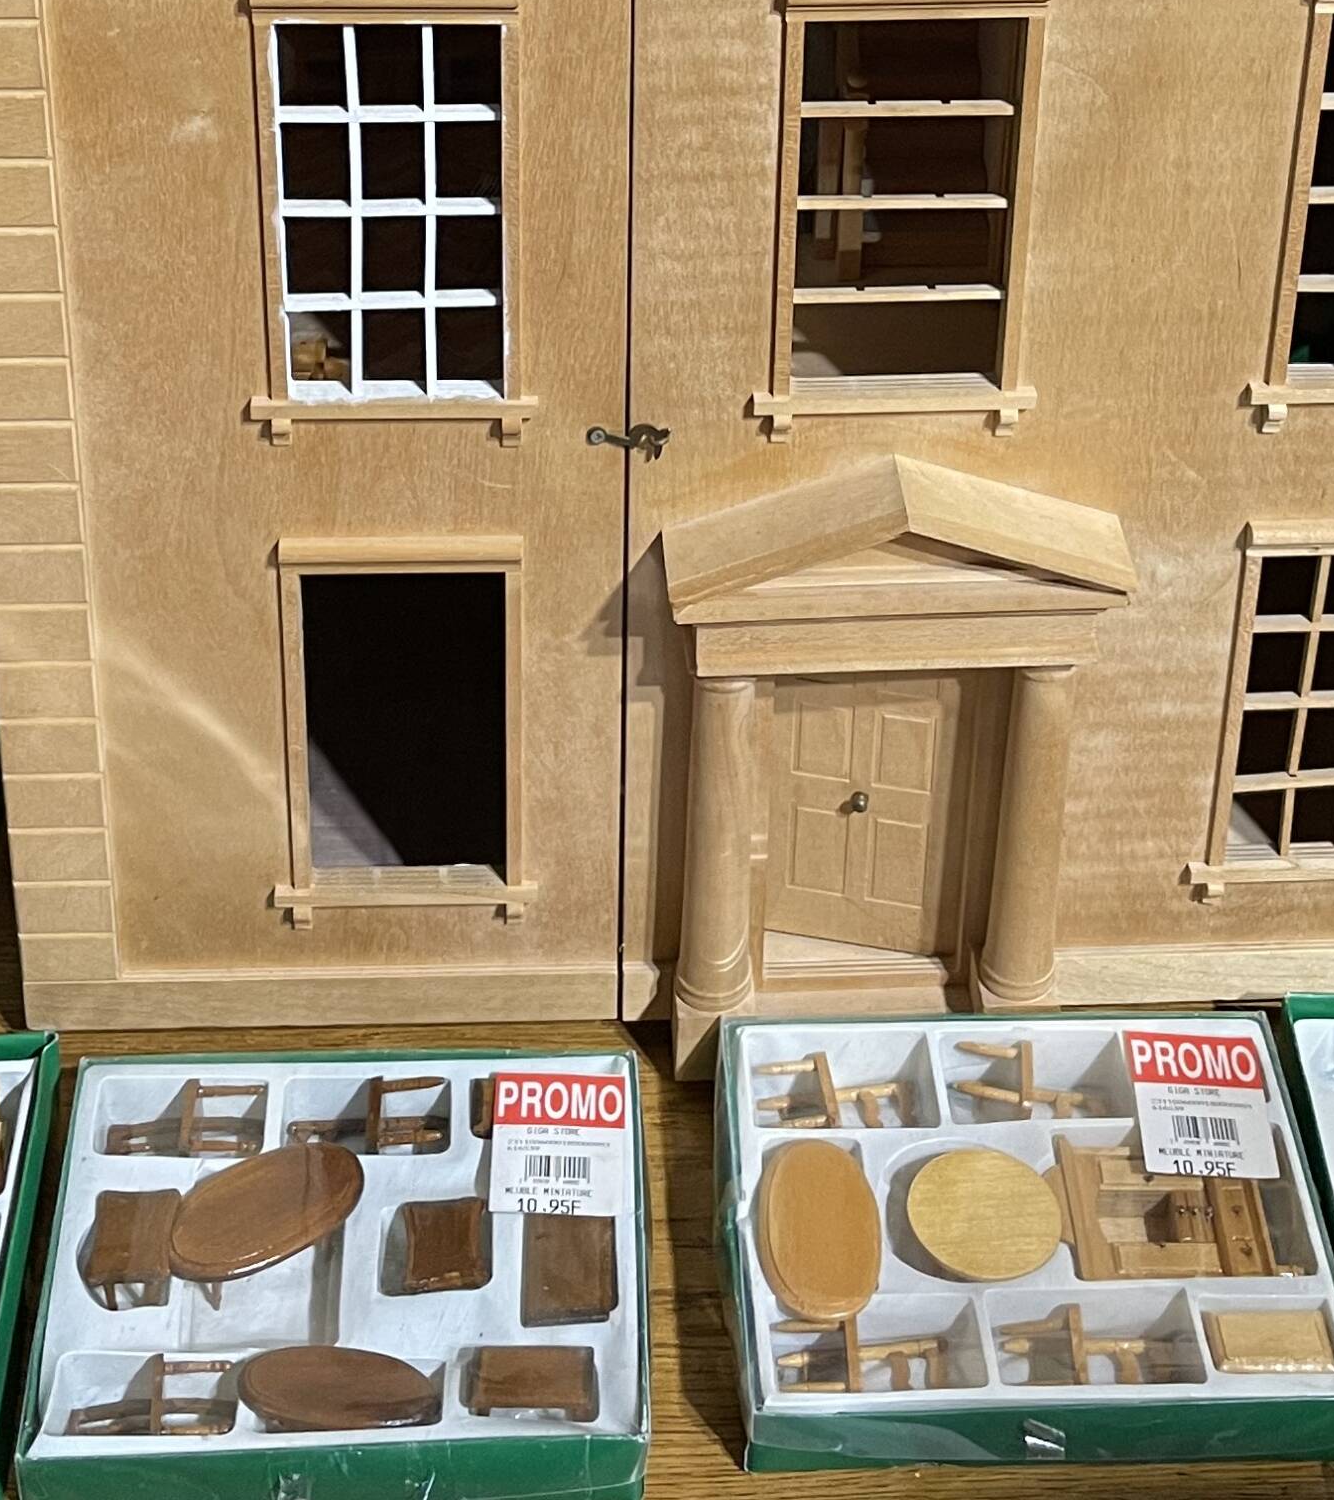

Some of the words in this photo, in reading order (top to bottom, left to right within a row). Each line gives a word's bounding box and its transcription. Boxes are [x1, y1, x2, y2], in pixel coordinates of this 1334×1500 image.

[1131, 1039, 1257, 1082] PROMO
[1167, 1086, 1190, 1095] GIGA
[1194, 1087, 1221, 1097] STORE
[497, 1080, 623, 1122] PROMO
[527, 1126, 549, 1135] GIGA
[553, 1127, 580, 1136] STORE
[1158, 1147, 1192, 1157] MEUBLE
[1196, 1149, 1244, 1160] MINIATURE
[1172, 1160, 1237, 1177] 10.95F
[505, 1186, 538, 1196] MEUBLE
[543, 1187, 593, 1198] MINIATURE
[517, 1197, 583, 1215] 10.95F
